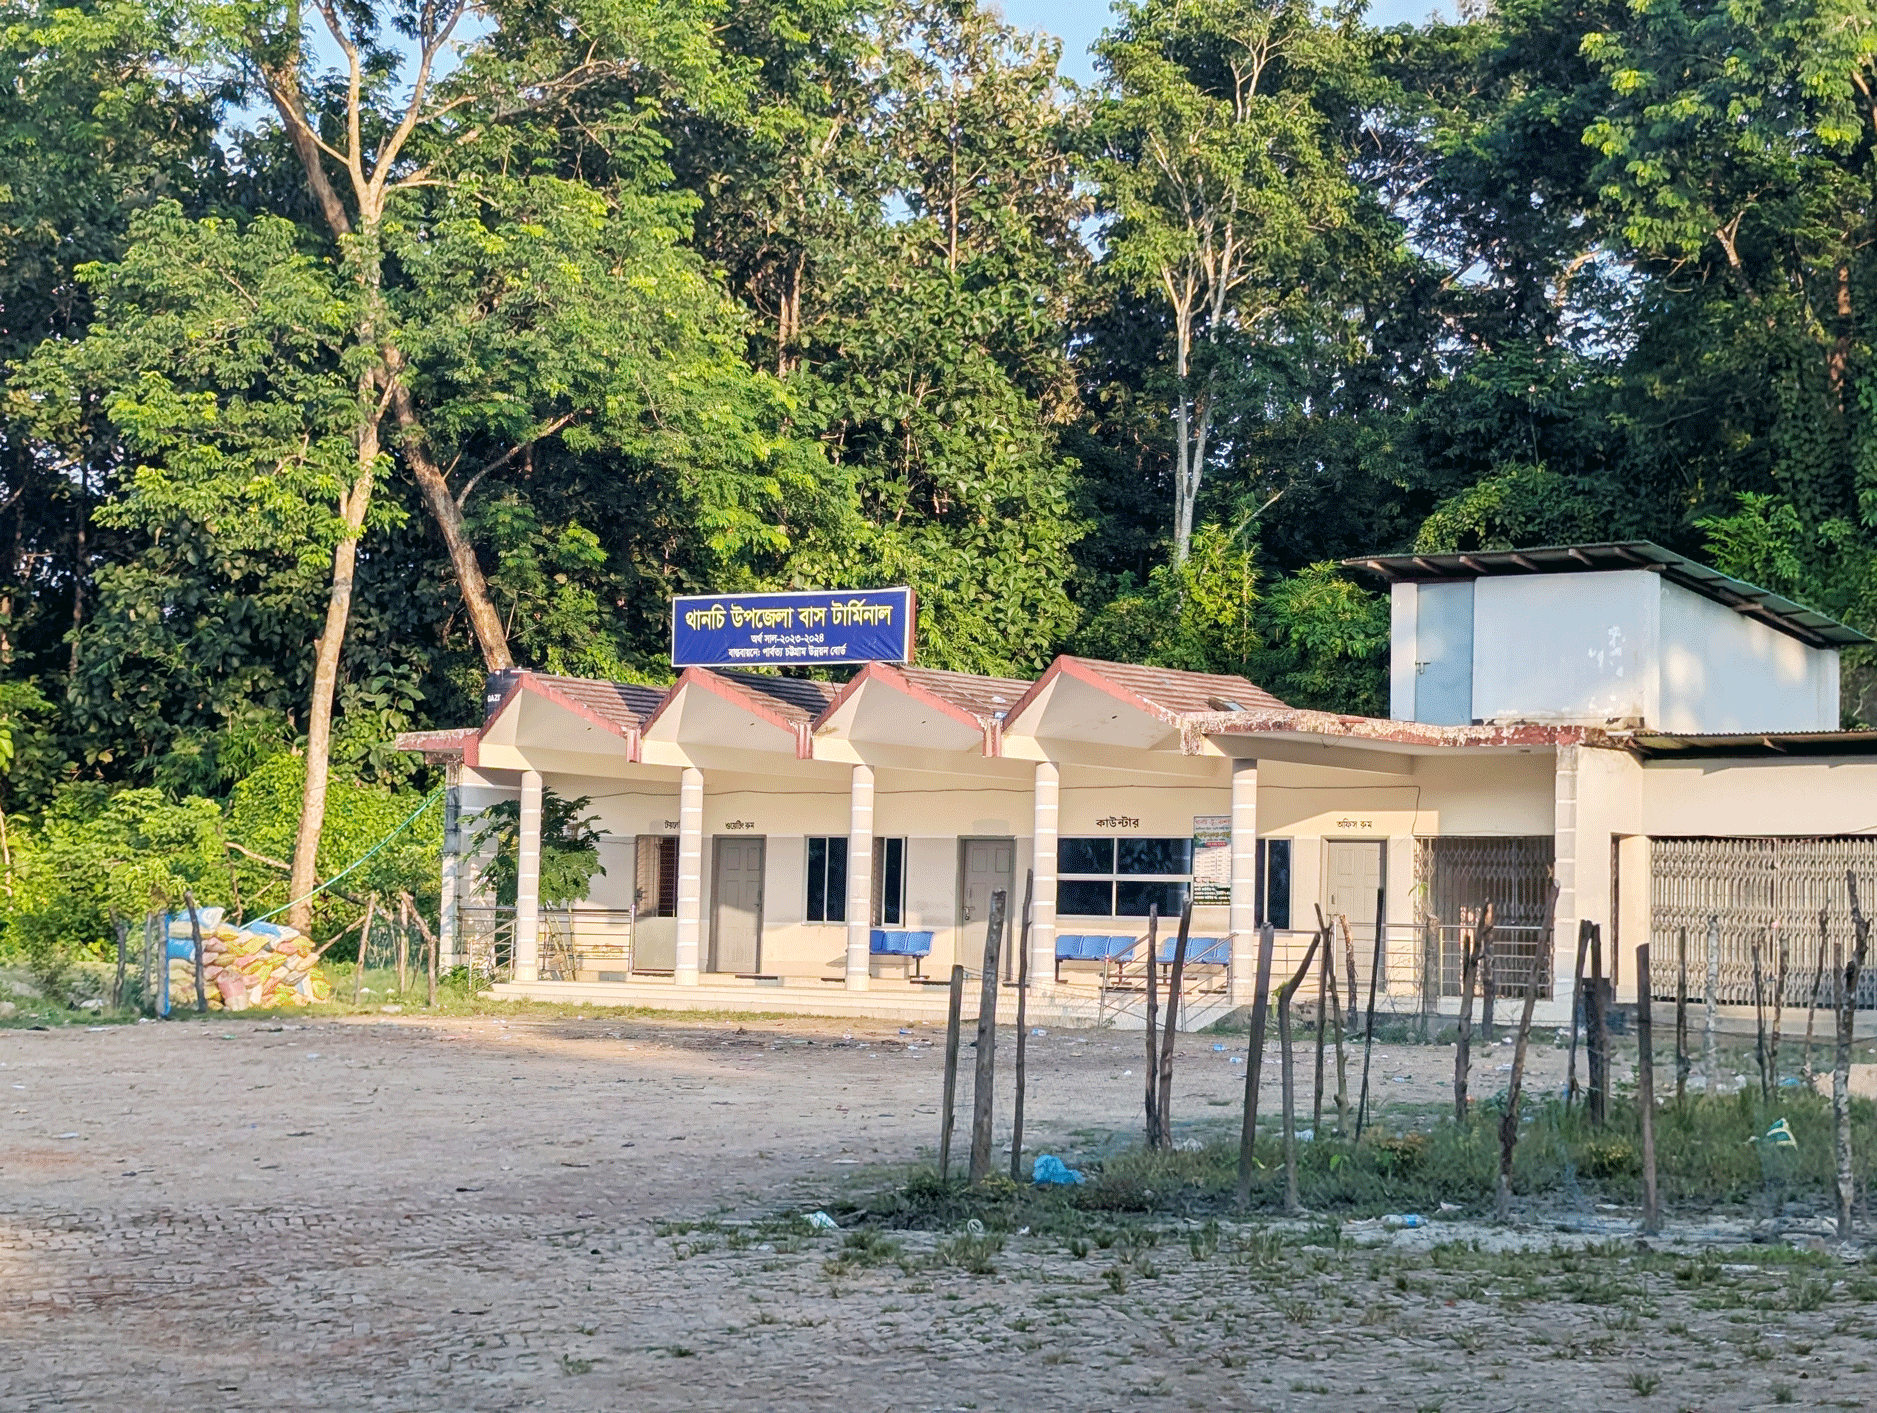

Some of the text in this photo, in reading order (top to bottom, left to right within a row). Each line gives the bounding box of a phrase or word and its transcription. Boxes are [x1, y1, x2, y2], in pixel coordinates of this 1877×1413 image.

[685, 598, 893, 630] থানচি উপজেলা বাস টার্মিনাল
[762, 645, 783, 657] পার্বত্য
[807, 643, 829, 658] উন্নয়ন
[830, 642, 847, 656] বোর্ড
[1095, 815, 1140, 829] কাউন্টার
[1336, 817, 1372, 830] অফিস রুম
